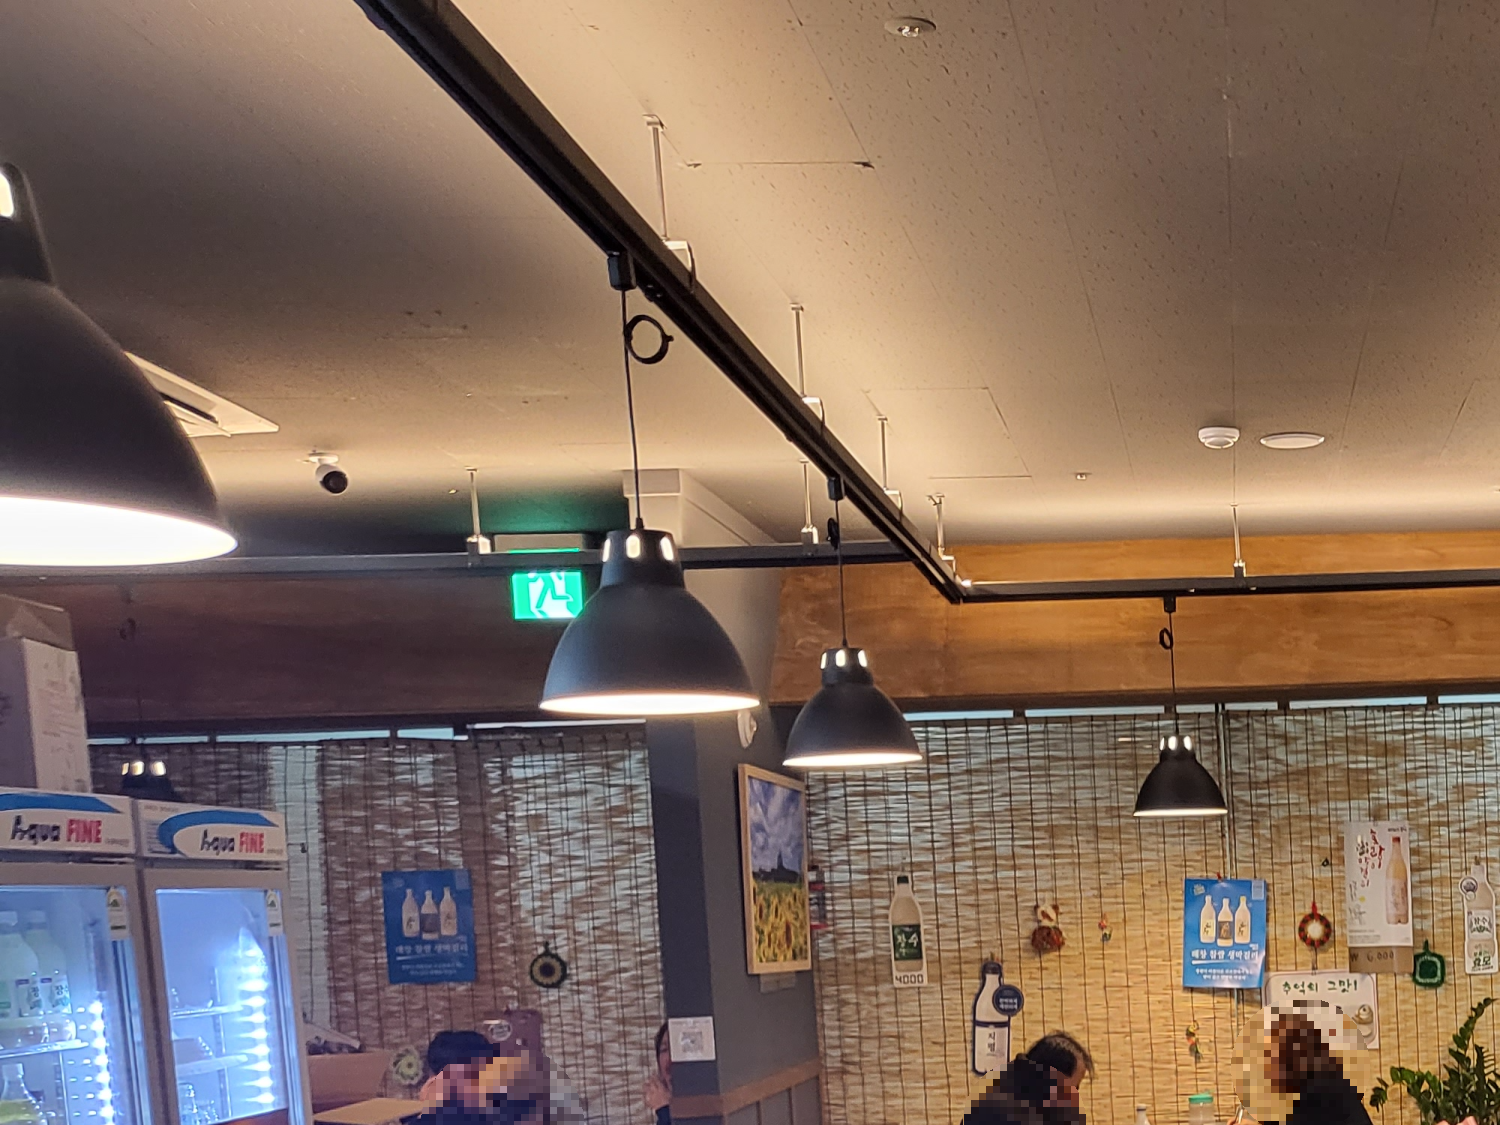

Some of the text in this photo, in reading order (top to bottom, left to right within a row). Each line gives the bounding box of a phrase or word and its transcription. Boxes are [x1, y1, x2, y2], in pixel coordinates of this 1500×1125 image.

[10, 815, 103, 845] Aqua FINE
[200, 829, 265, 856] Aqua FINE
[895, 974, 924, 985] 4000
